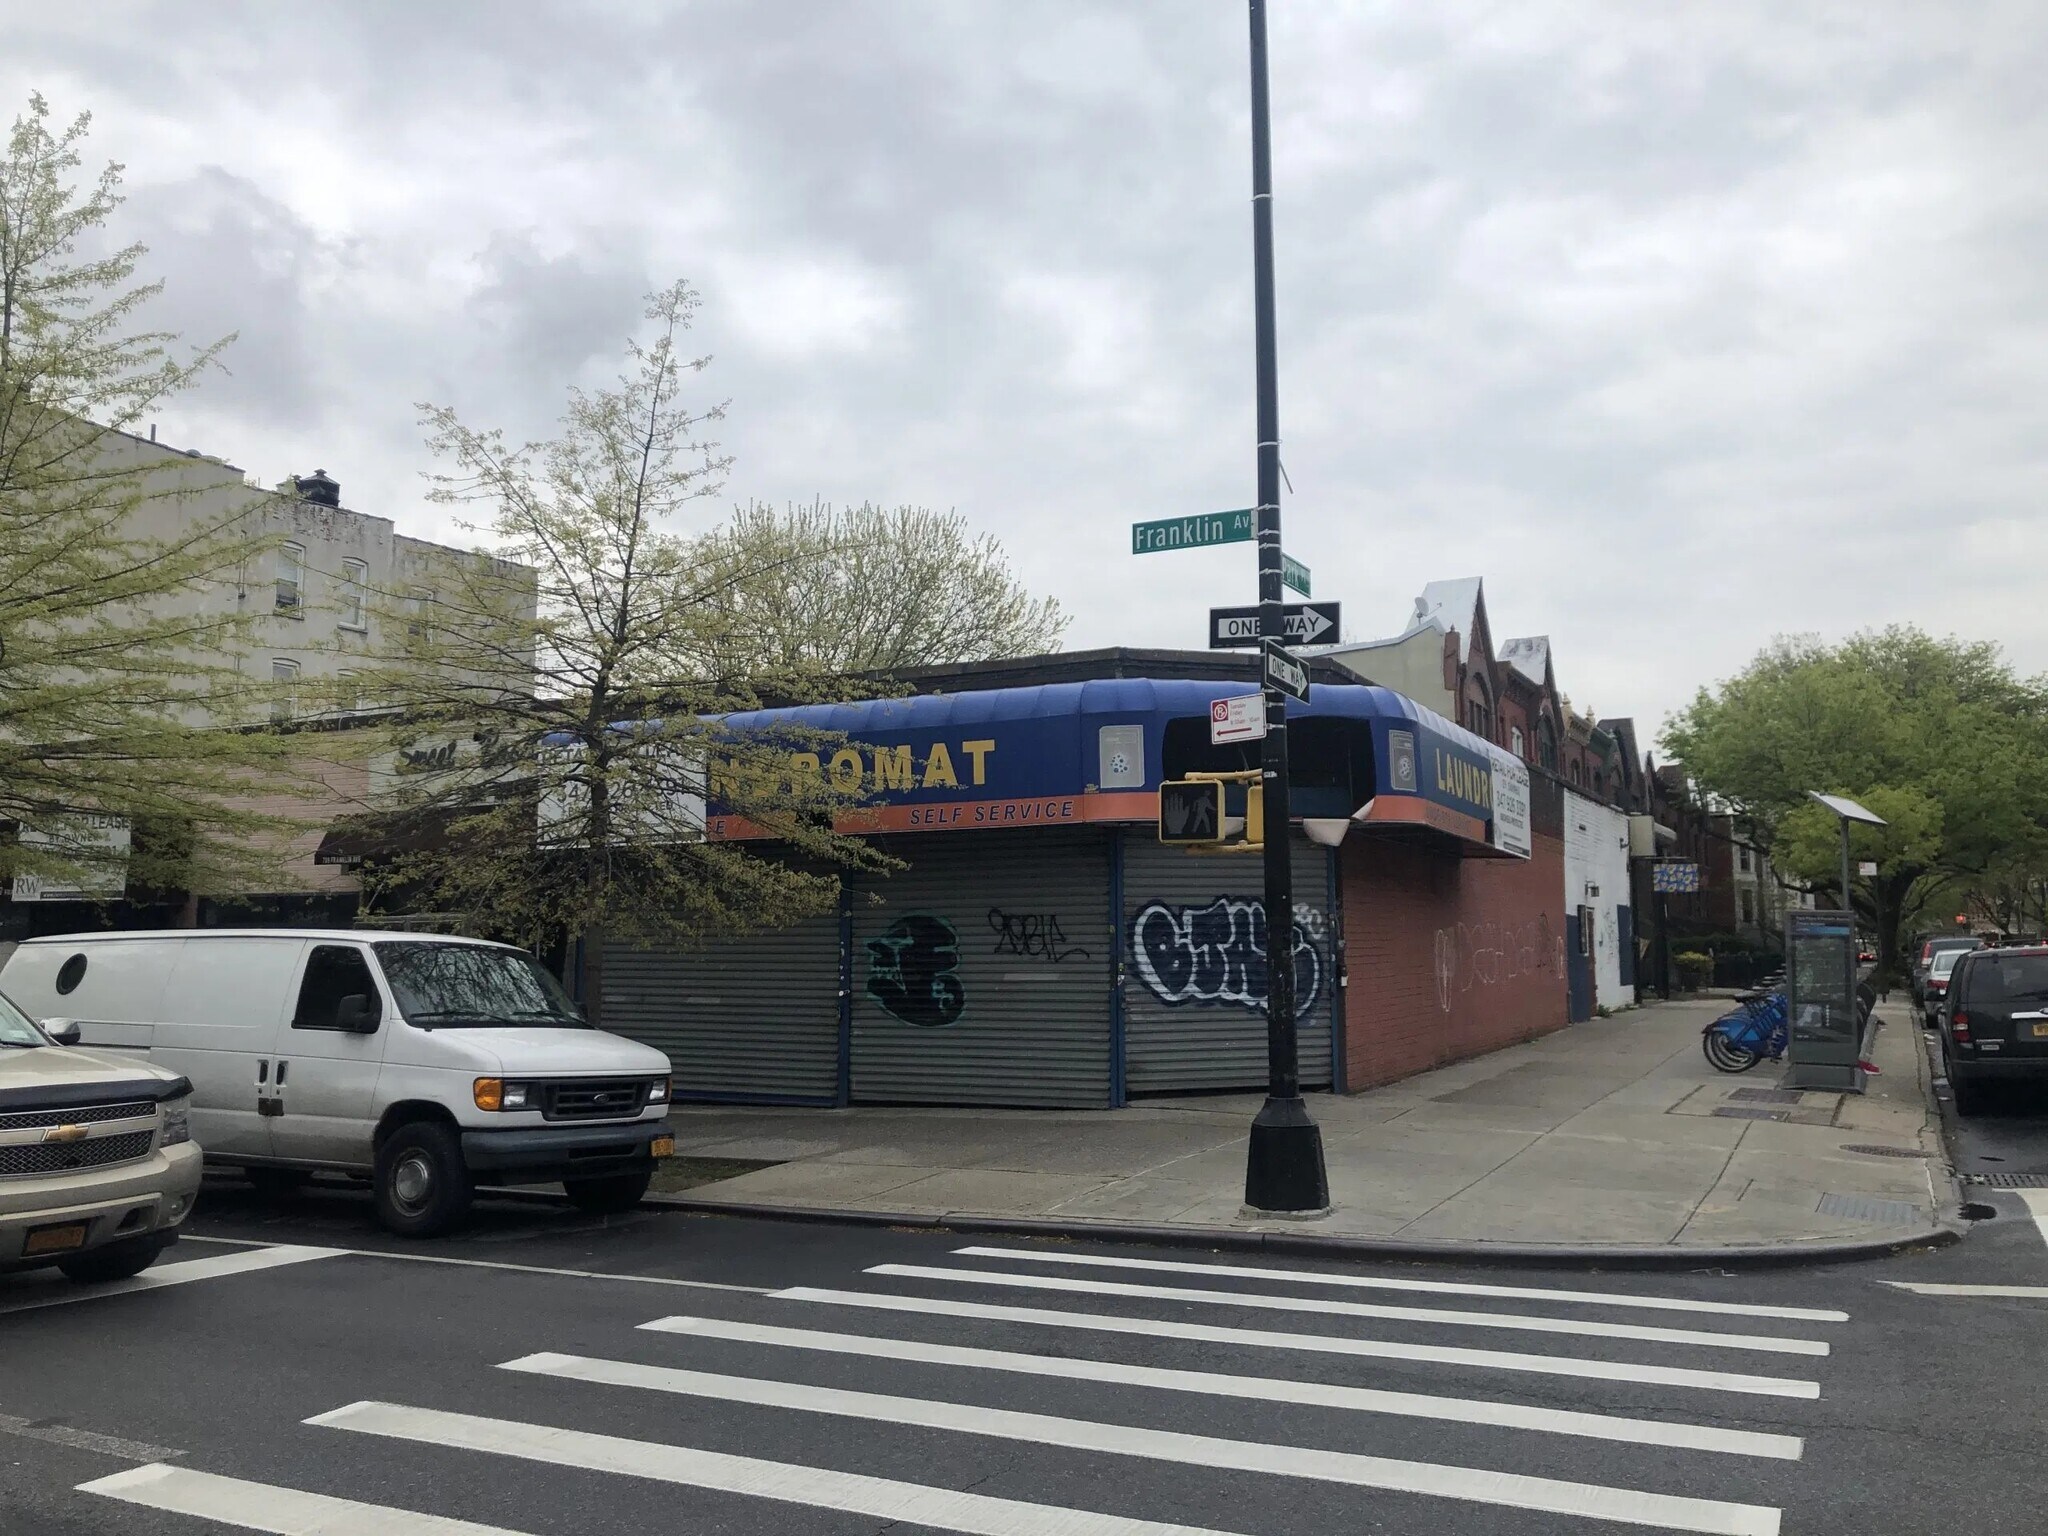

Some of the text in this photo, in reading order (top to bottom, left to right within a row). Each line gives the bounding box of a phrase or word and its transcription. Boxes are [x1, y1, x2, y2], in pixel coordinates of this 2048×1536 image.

[1136, 514, 1250, 549] Franklin Av
[1228, 616, 1320, 636] ONE WAY
[1272, 658, 1304, 690] ONE WAY
[910, 807, 962, 825] SELF
[974, 801, 1073, 822] SERVICE
